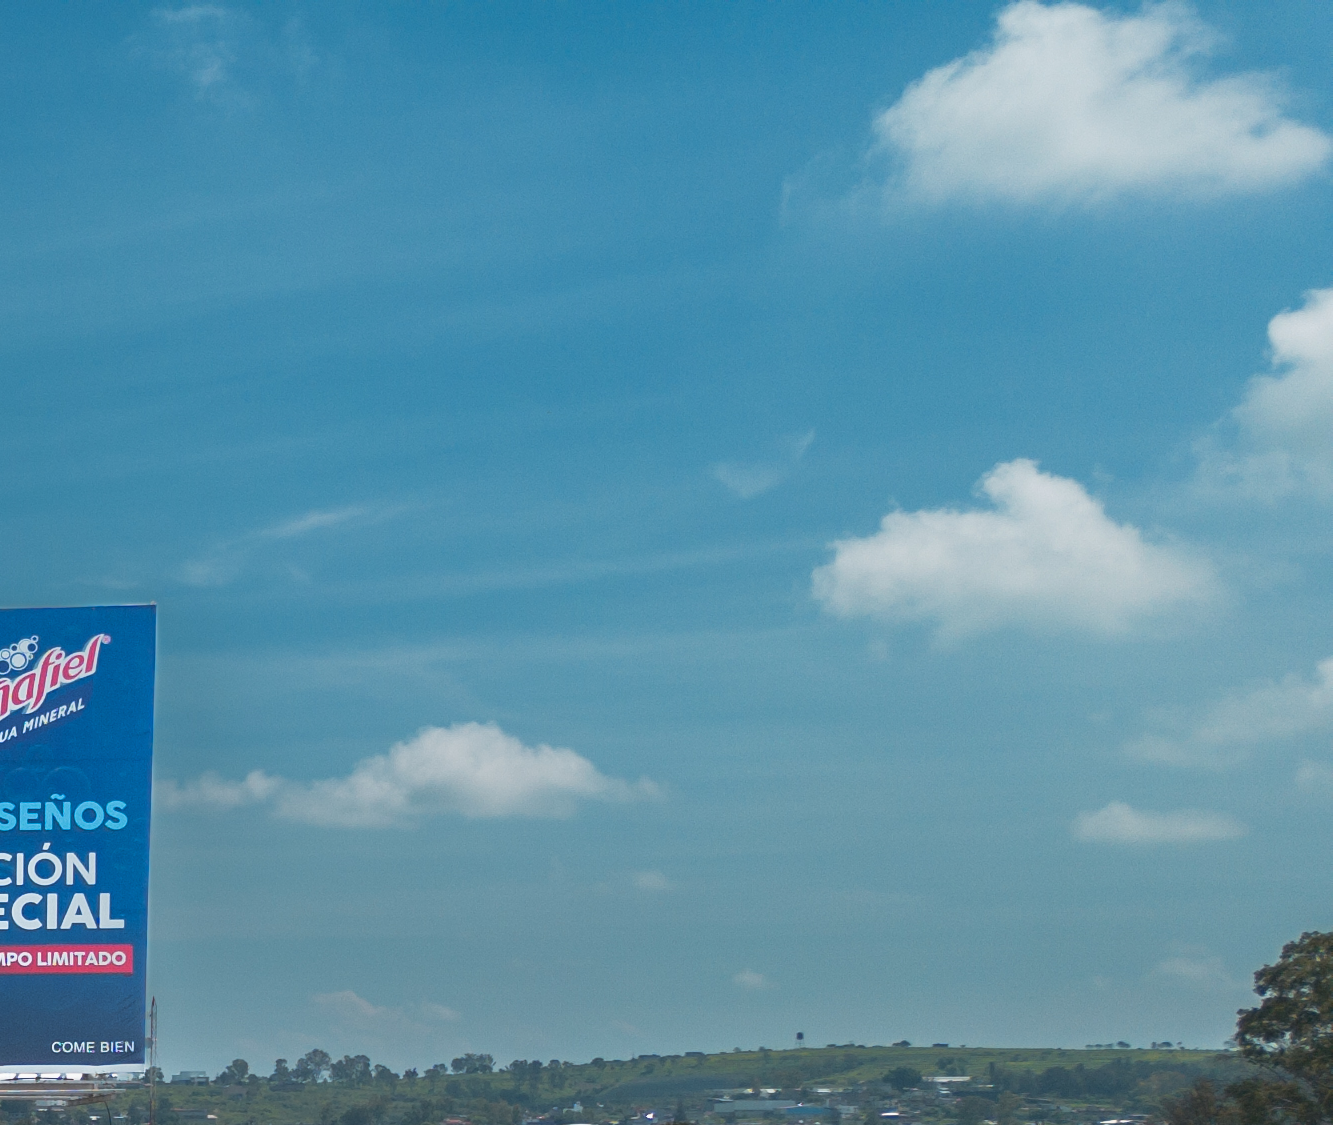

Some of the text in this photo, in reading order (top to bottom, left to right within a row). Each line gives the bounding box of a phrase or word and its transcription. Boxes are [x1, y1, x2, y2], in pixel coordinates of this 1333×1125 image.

[22, 698, 85, 734] MINERAL
[36, 951, 127, 967] LIMITADO
[51, 1040, 135, 1053] COME BIEN
